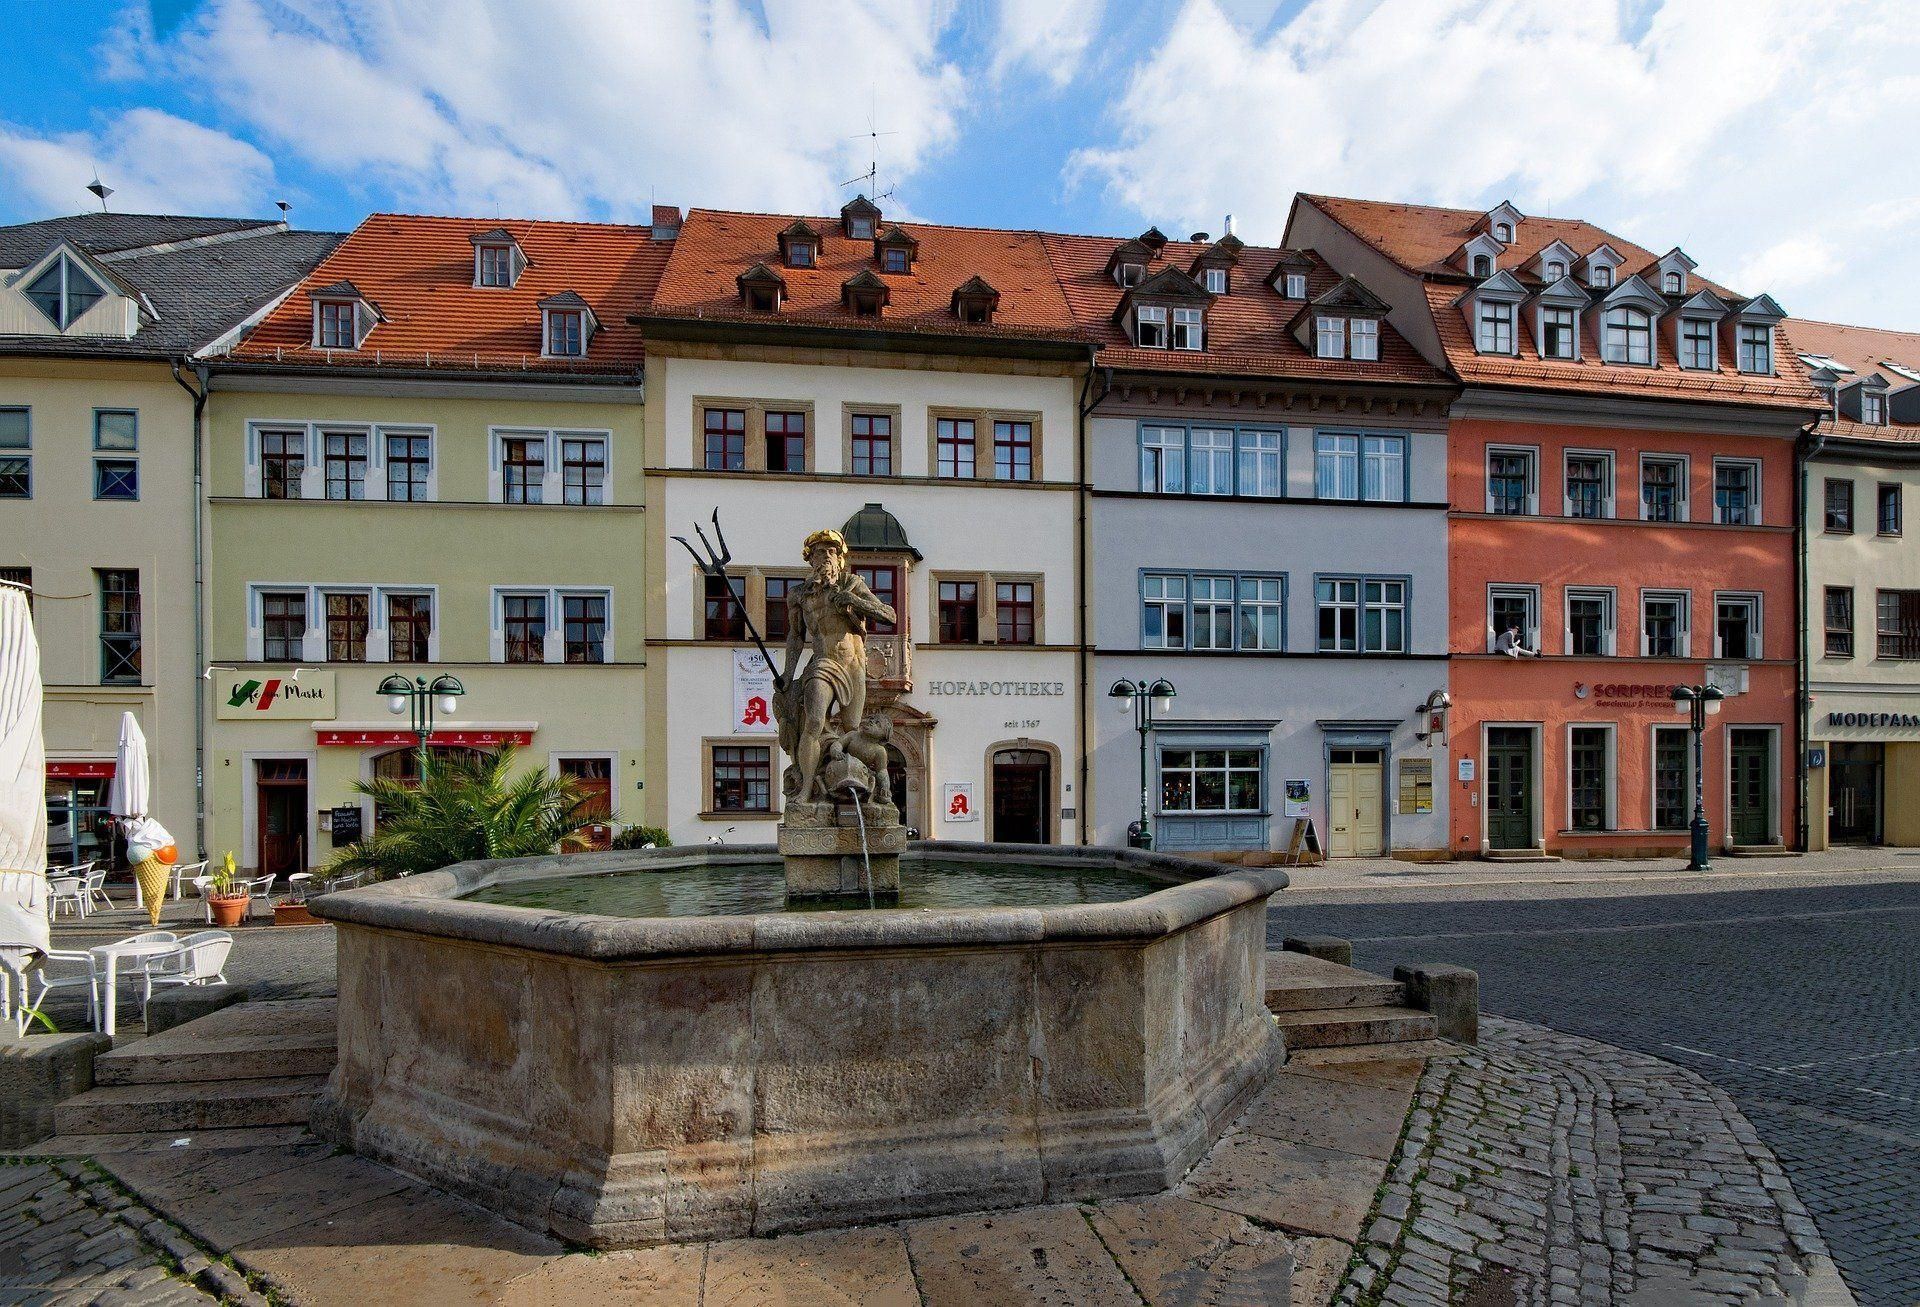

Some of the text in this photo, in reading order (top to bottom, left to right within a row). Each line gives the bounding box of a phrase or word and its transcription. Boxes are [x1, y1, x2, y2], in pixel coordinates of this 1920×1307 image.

[285, 684, 324, 700] Markt
[929, 681, 1065, 696] HOFAPOTHEKE
[1594, 684, 1676, 698] SORPRES
[1004, 720, 1040, 728] seit 1567
